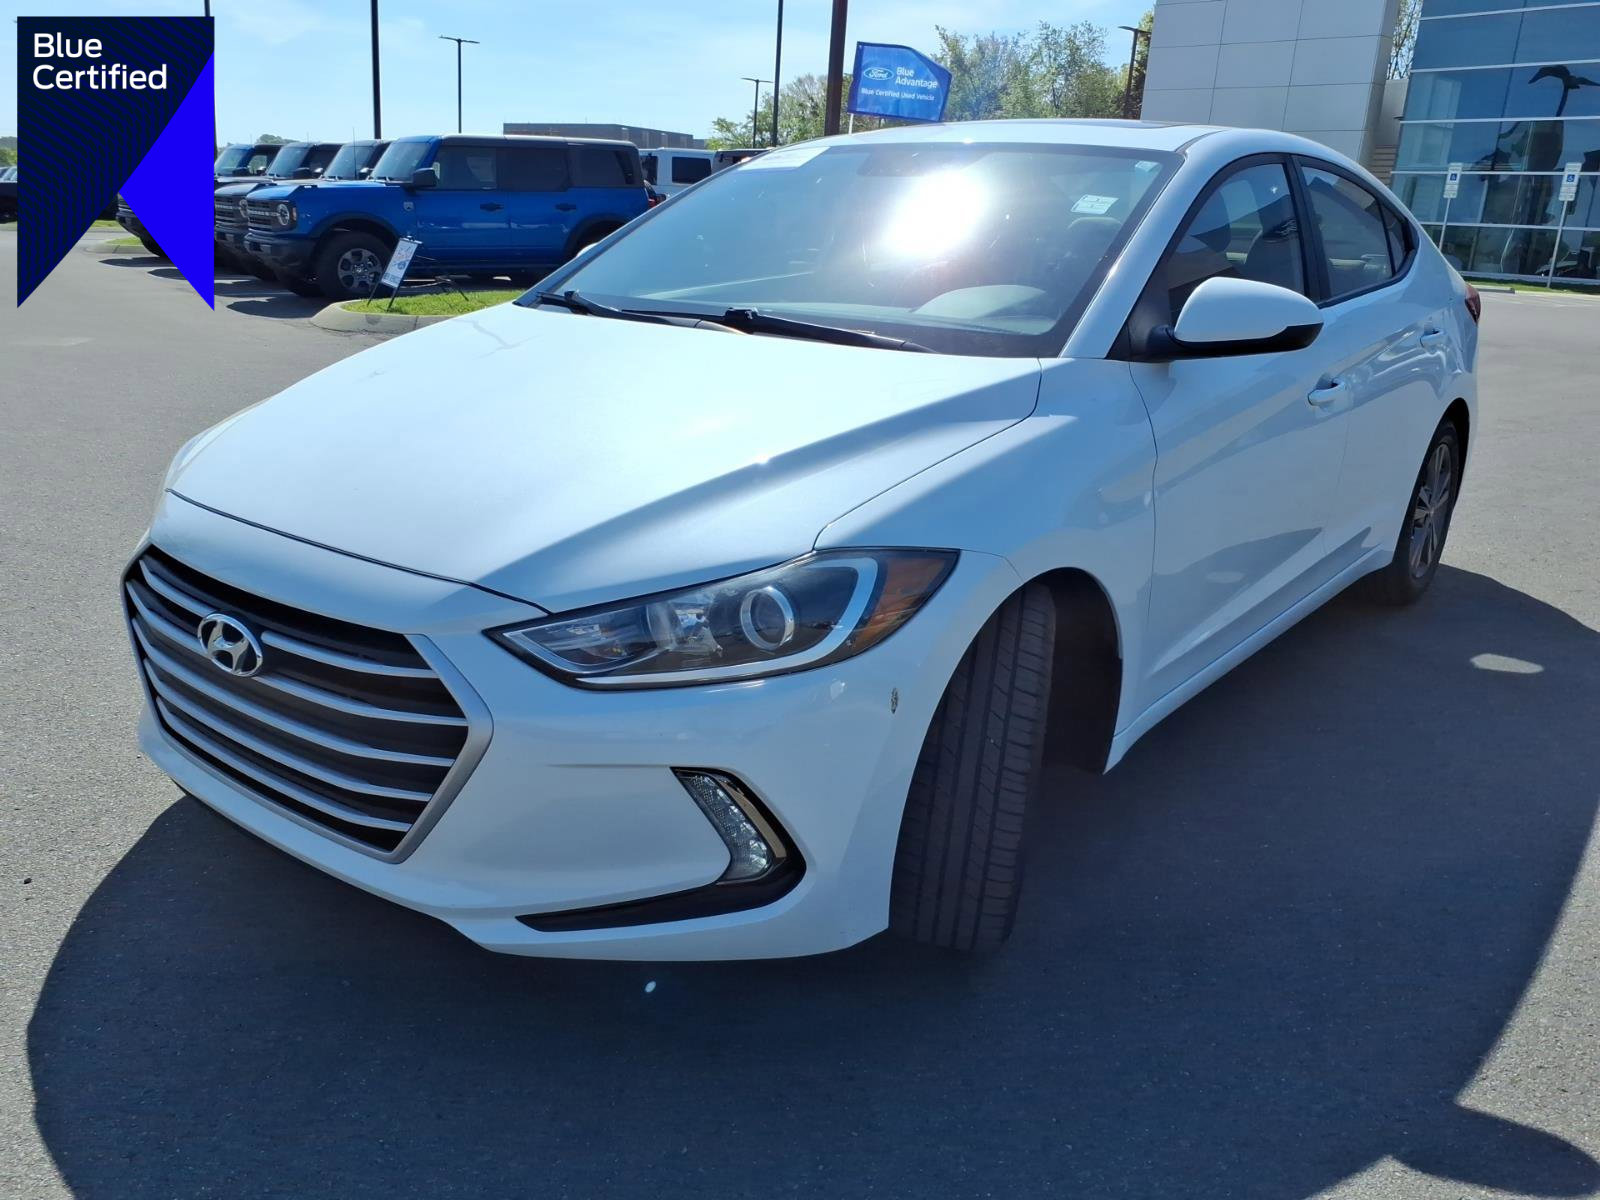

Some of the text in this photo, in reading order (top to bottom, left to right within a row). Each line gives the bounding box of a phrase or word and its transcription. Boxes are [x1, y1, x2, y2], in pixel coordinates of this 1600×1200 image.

[868, 69, 888, 79] Ford
[896, 67, 914, 77] Blue
[895, 77, 938, 89] Advantage
[875, 89, 899, 97] Certified
[901, 91, 915, 99] Used
